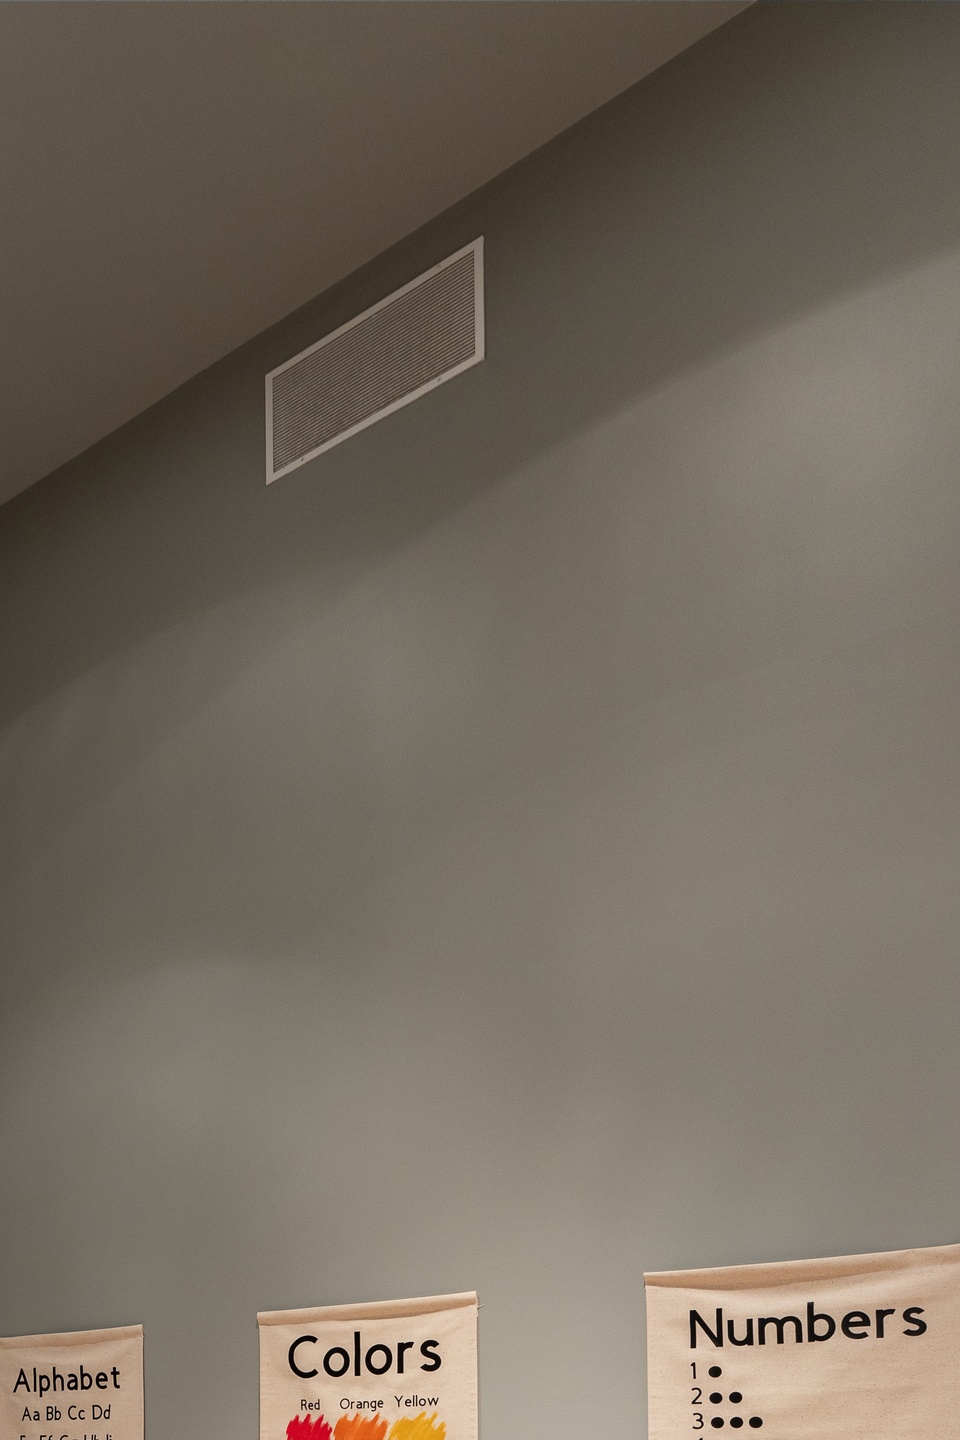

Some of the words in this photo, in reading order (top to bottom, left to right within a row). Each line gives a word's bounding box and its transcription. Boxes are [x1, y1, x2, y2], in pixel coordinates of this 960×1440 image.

[689, 1302, 928, 1348] Numbers
[288, 1332, 442, 1378] Colors
[690, 1363, 697, 1379] 1
[12, 1365, 121, 1397] Alphabet
[300, 1399, 321, 1410] Red
[339, 1398, 384, 1411] Orange
[394, 1395, 440, 1407] Yellow
[691, 1388, 703, 1404] 2
[21, 1407, 41, 1421] Aa
[45, 1406, 62, 1421] Bb
[67, 1405, 86, 1420] Cc
[91, 1404, 112, 1420] Dd
[692, 1413, 705, 1429] 3
